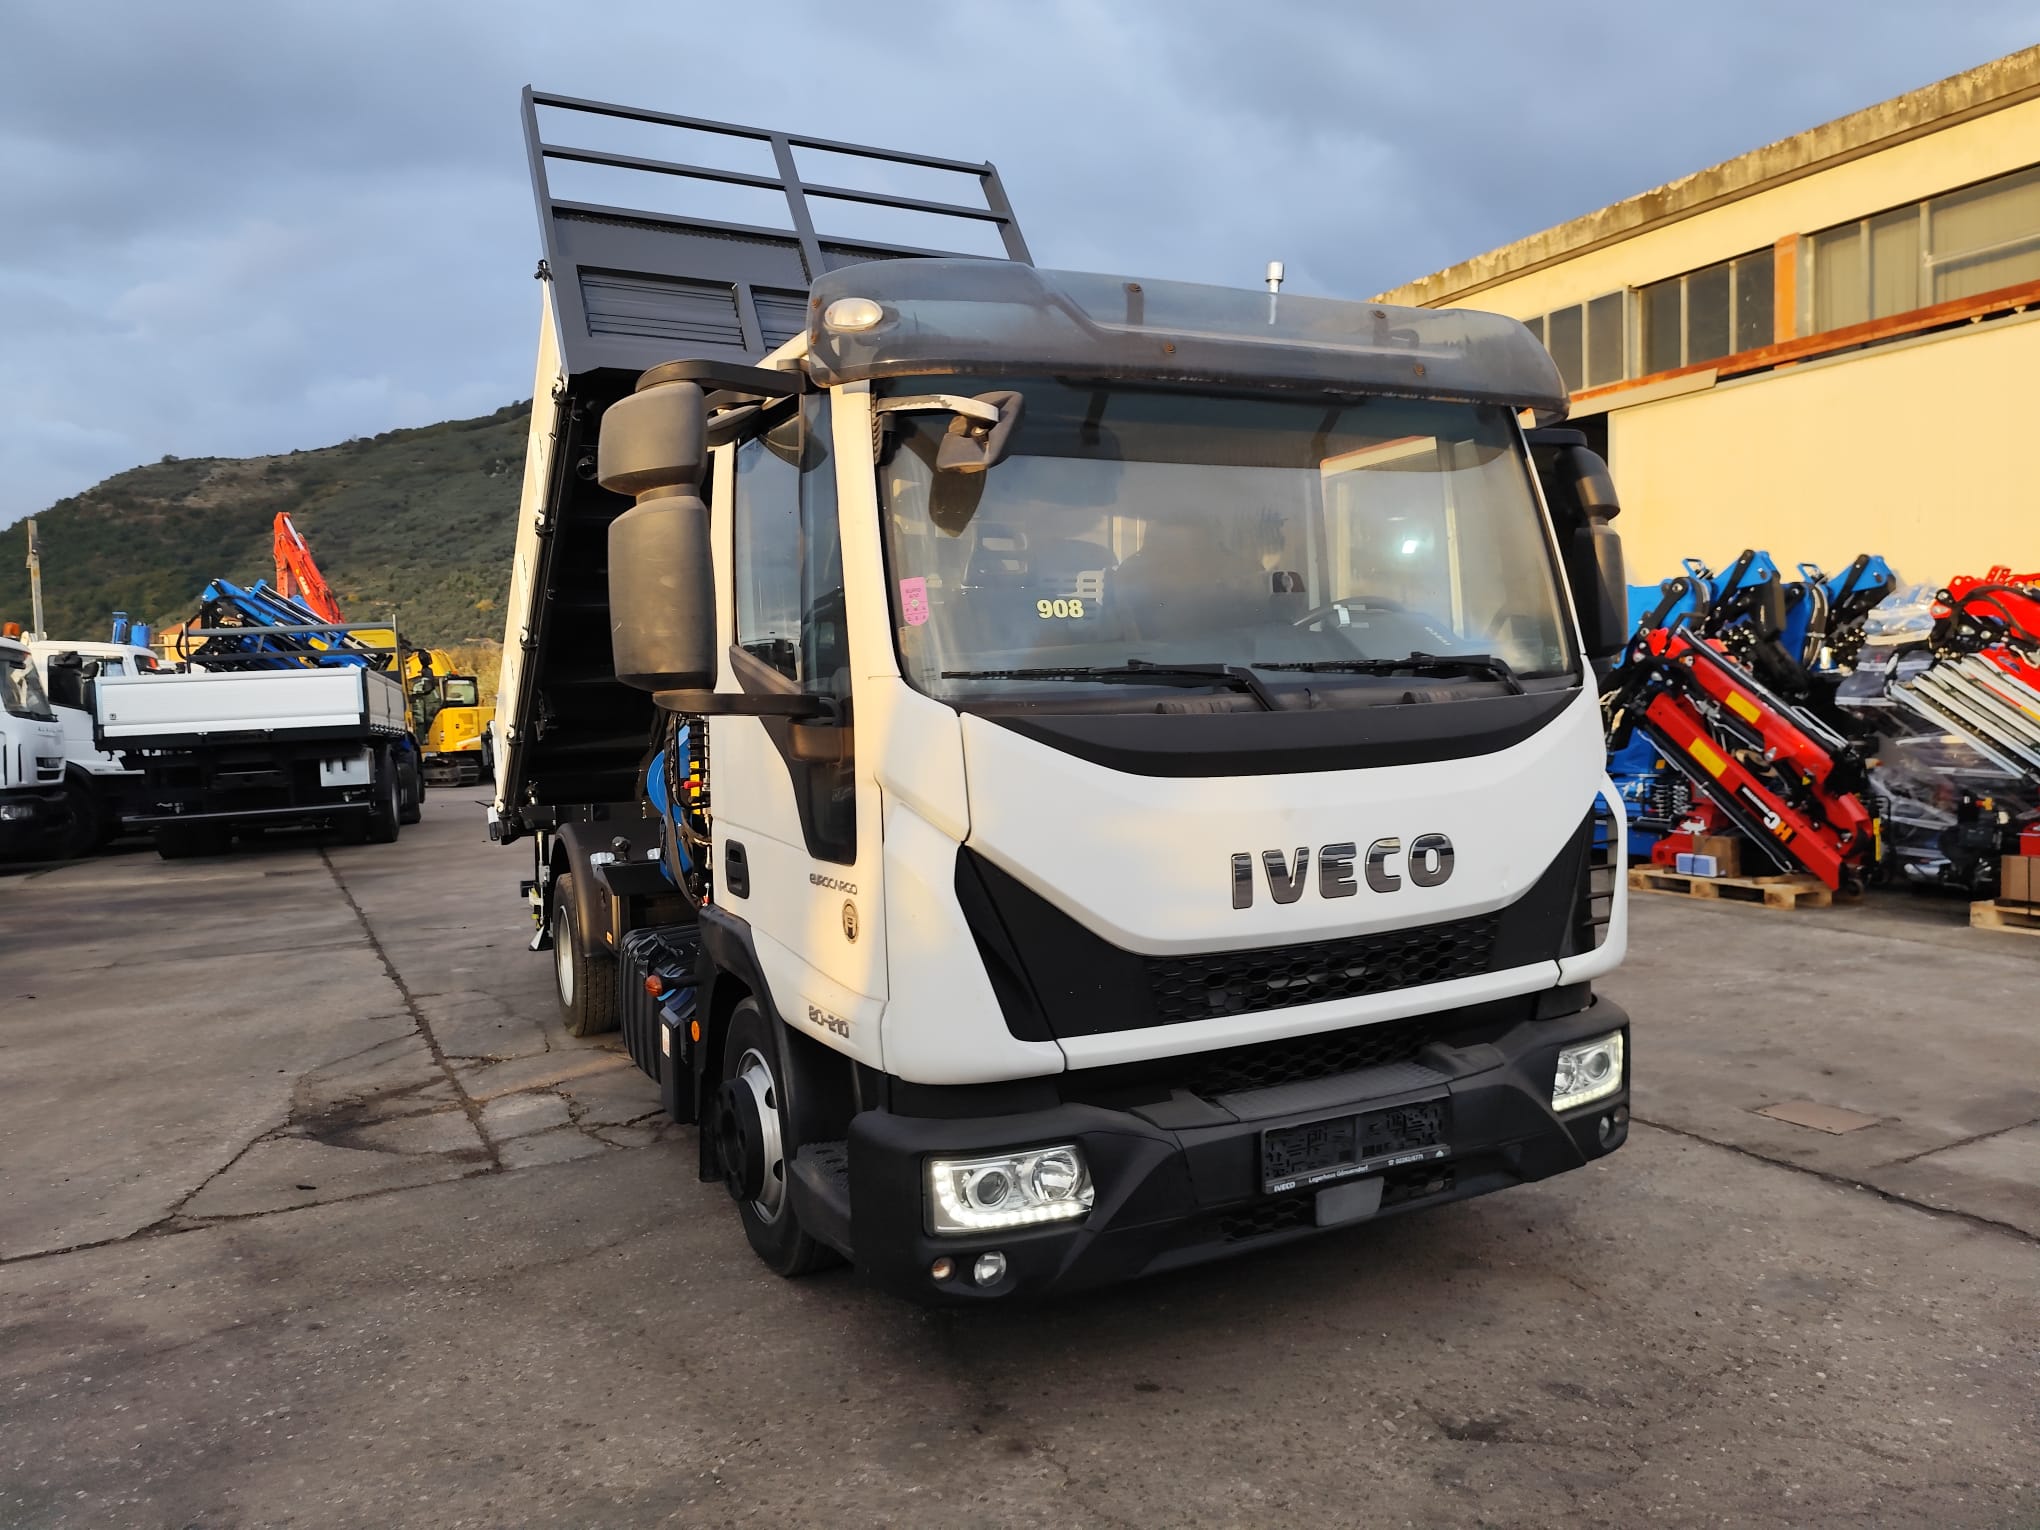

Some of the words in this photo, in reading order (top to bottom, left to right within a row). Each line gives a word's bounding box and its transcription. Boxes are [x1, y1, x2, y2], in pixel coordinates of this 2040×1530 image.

[1036, 599, 1085, 619] 908
[1231, 832, 1455, 909] IVECO
[1273, 1181, 1296, 1192] IVECO
